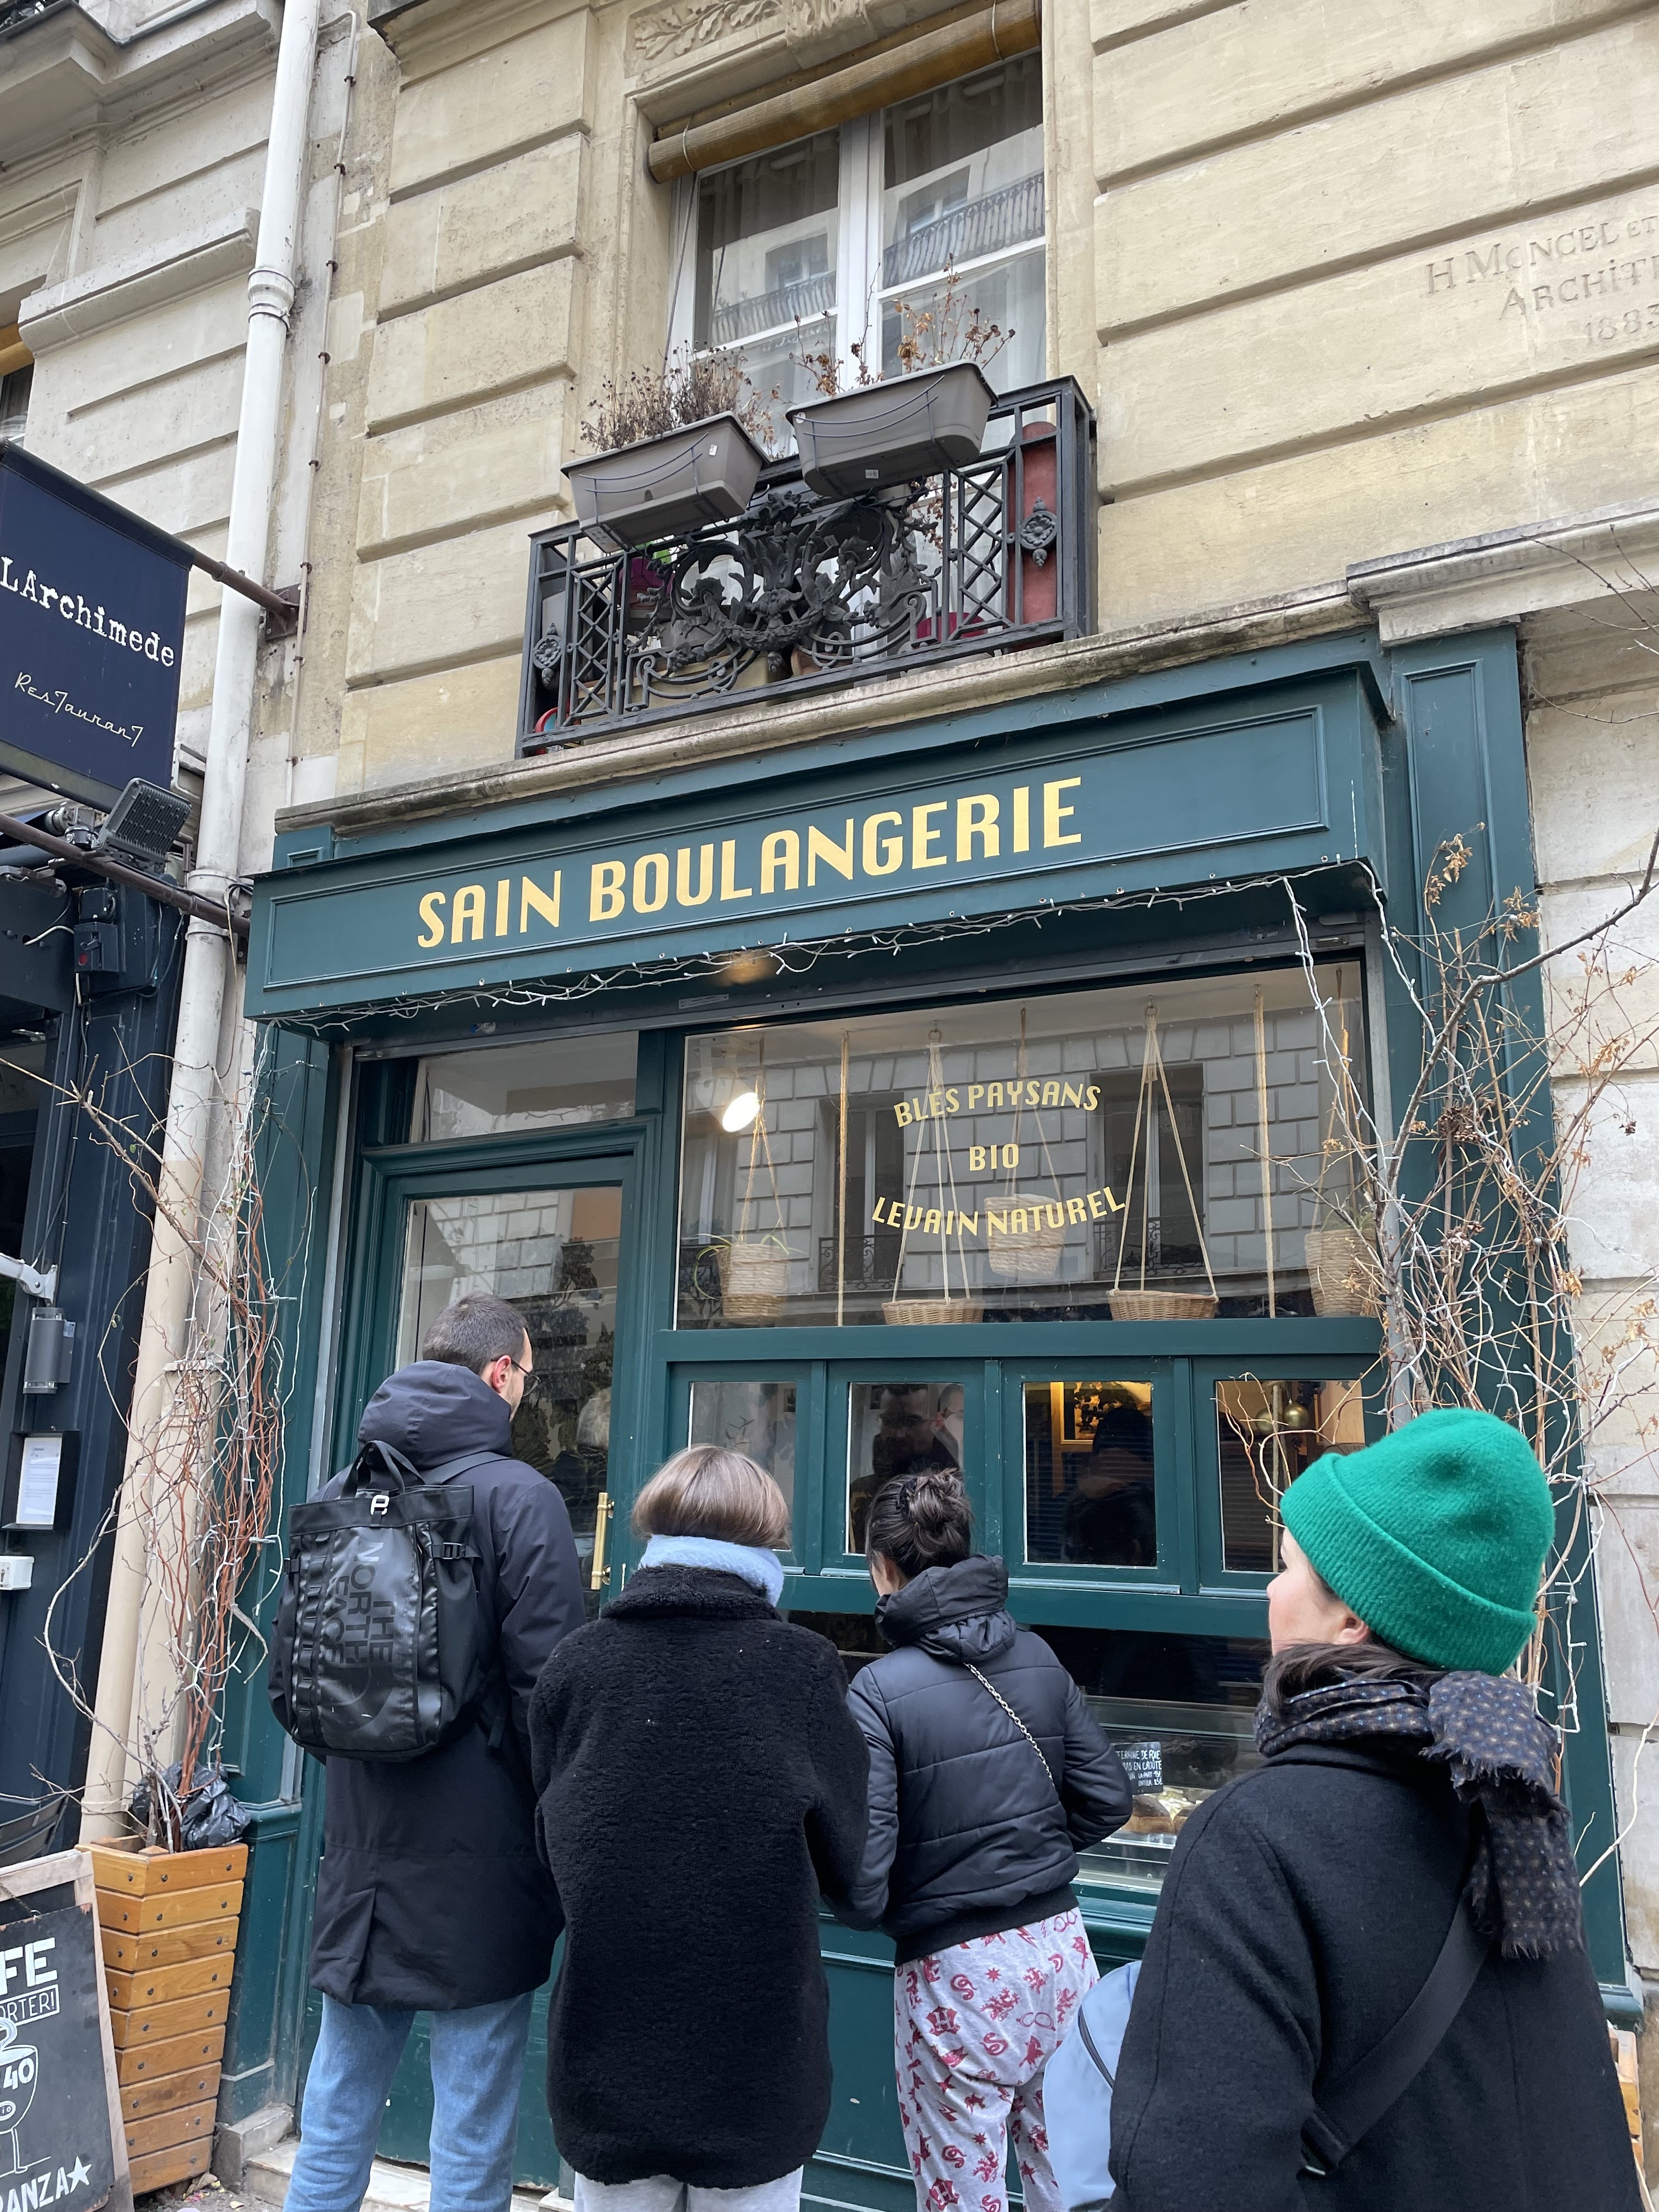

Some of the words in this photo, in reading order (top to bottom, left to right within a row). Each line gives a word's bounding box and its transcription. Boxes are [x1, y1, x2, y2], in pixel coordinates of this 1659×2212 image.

[1627, 215, 1658, 238] ET
[417, 869, 562, 948] SAIN
[589, 776, 1082, 922] BOULANGERIE
[968, 1080, 1101, 1111] PAYSANS
[969, 1143, 1019, 1171] BIO
[872, 1197, 979, 1236] LEVAIN
[988, 1187, 1126, 1236] NATUREL
[345, 1542, 384, 1664] NORTH
[368, 1600, 396, 1663] THE
[1141, 1750, 1148, 1760] DE
[0, 2166, 70, 2212] ANZA
